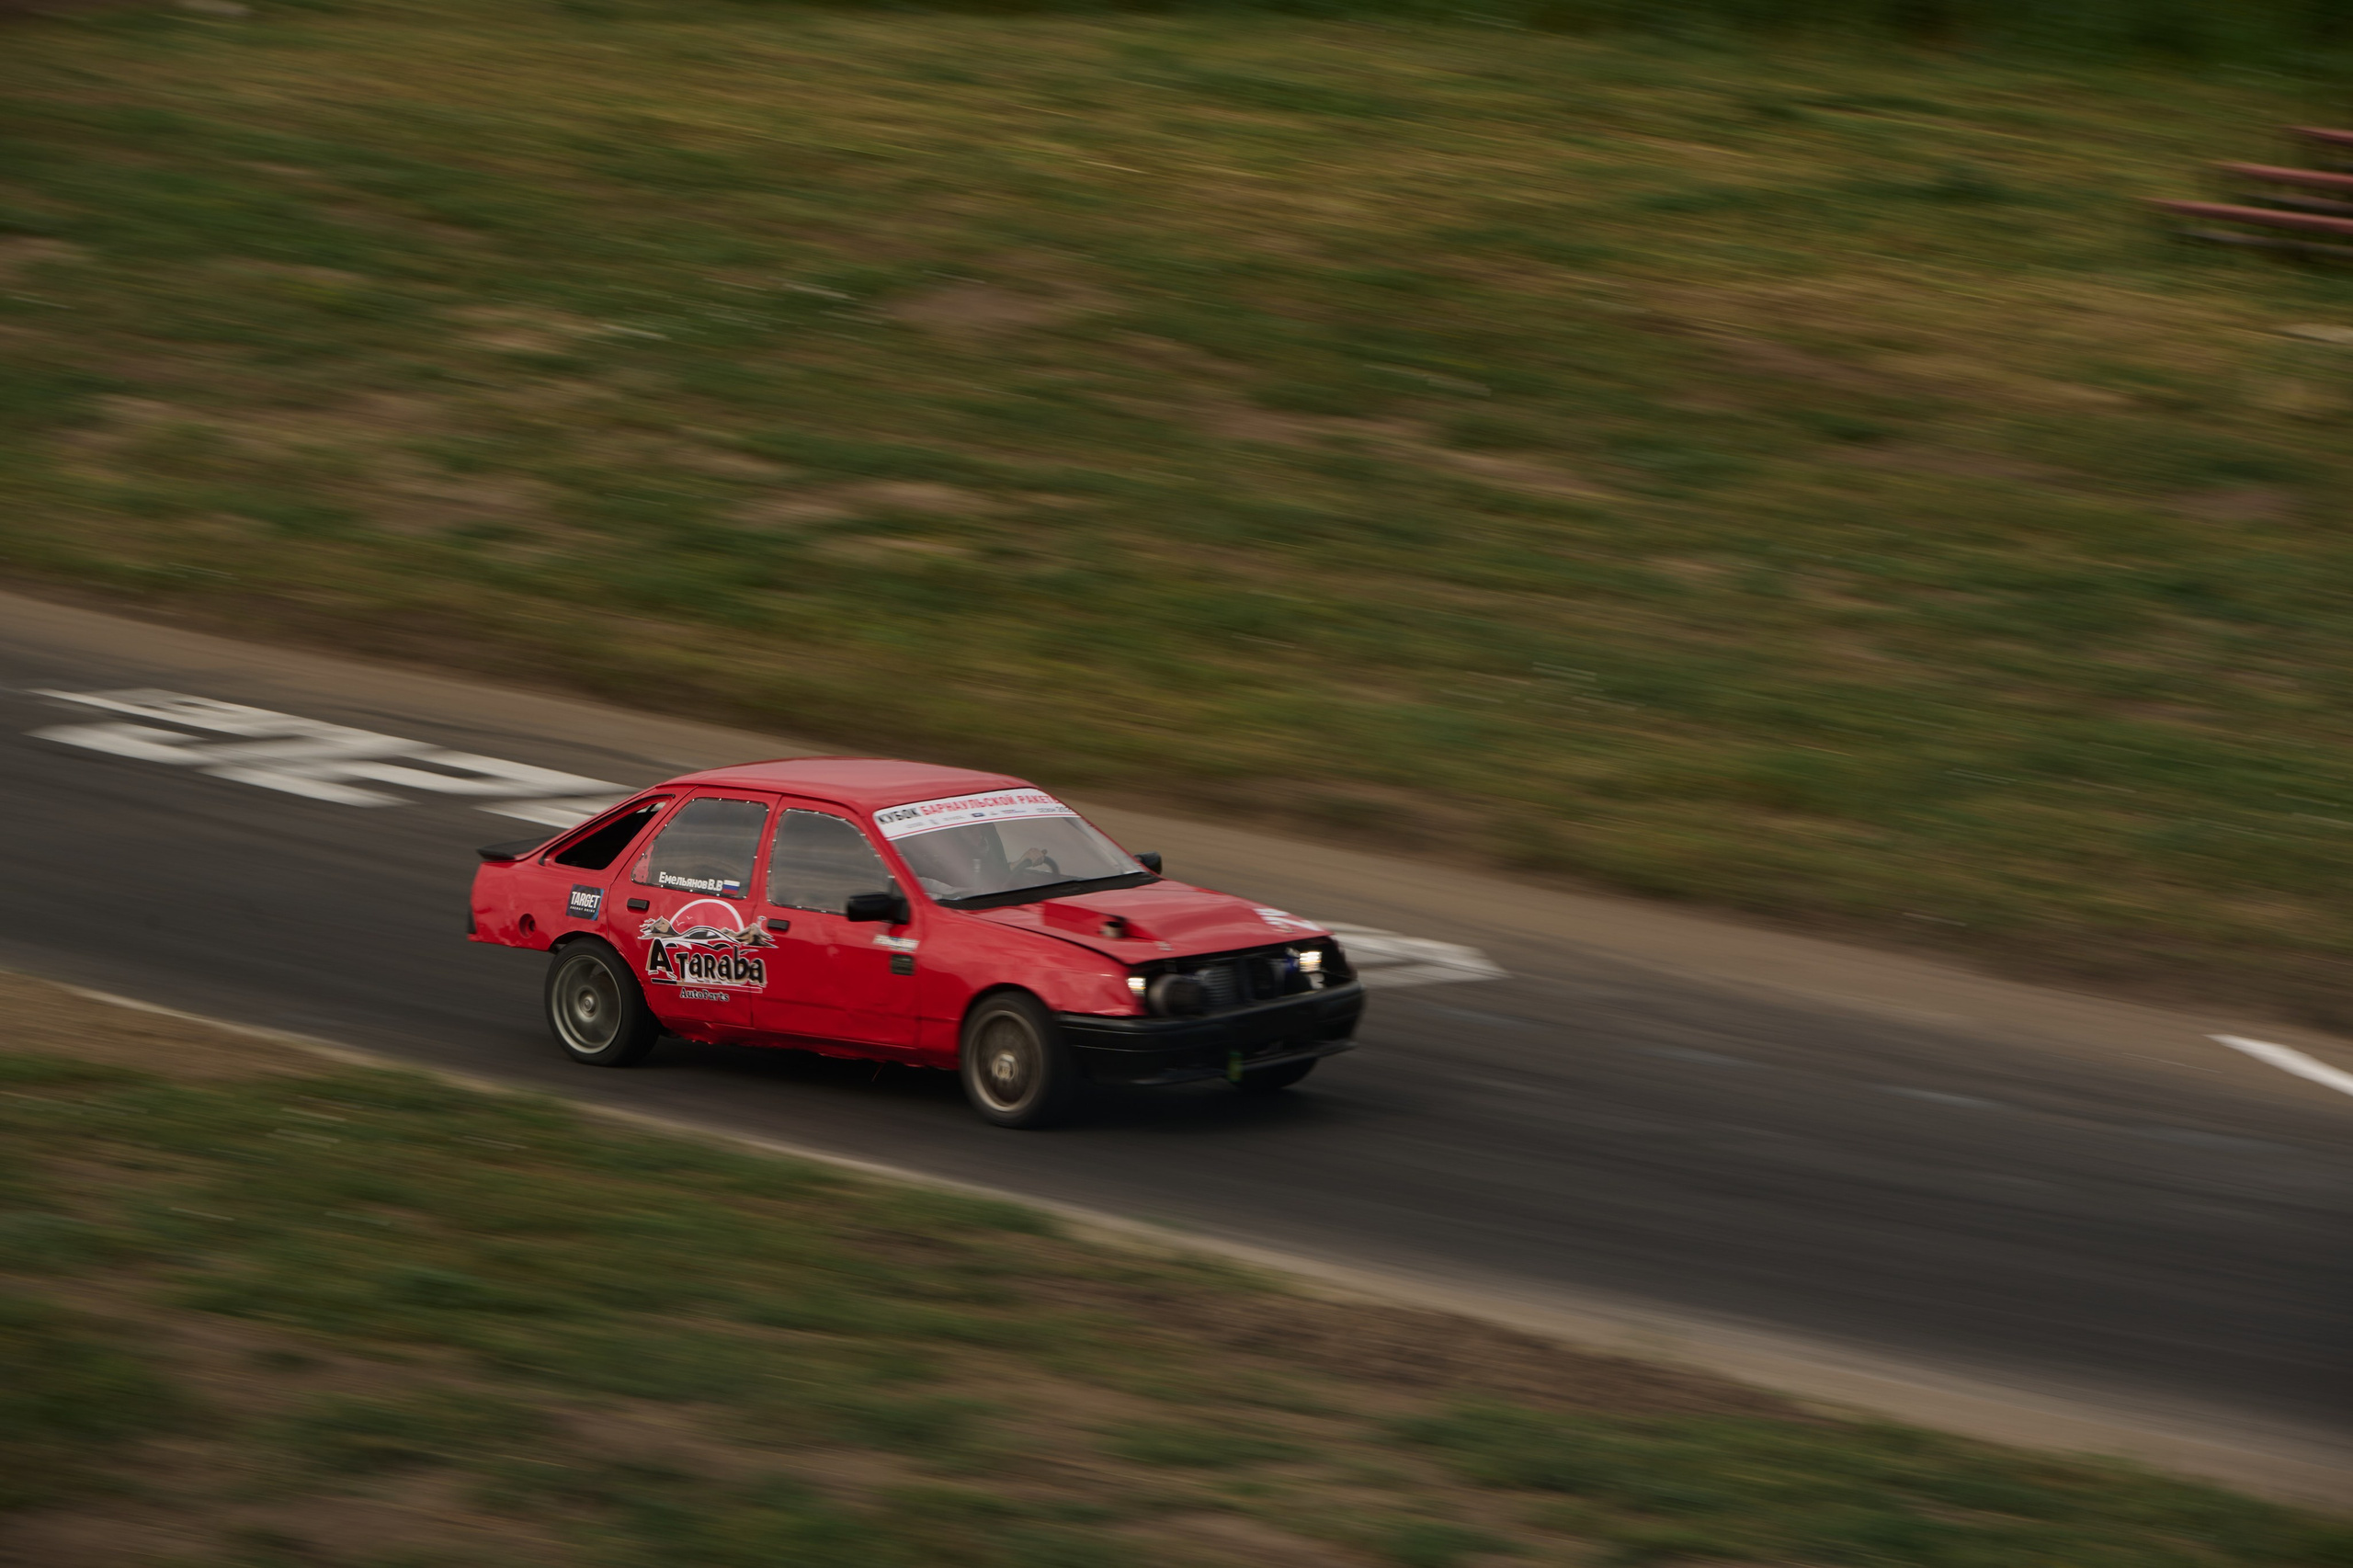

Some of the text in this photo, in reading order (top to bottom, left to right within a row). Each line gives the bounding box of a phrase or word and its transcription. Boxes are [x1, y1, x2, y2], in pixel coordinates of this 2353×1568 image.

[877, 807, 922, 825] КУБОК
[920, 794, 1015, 816] БАРНАУЛЬСКОЙ
[571, 891, 601, 909] TARGET
[679, 987, 730, 1002] AutoParts
